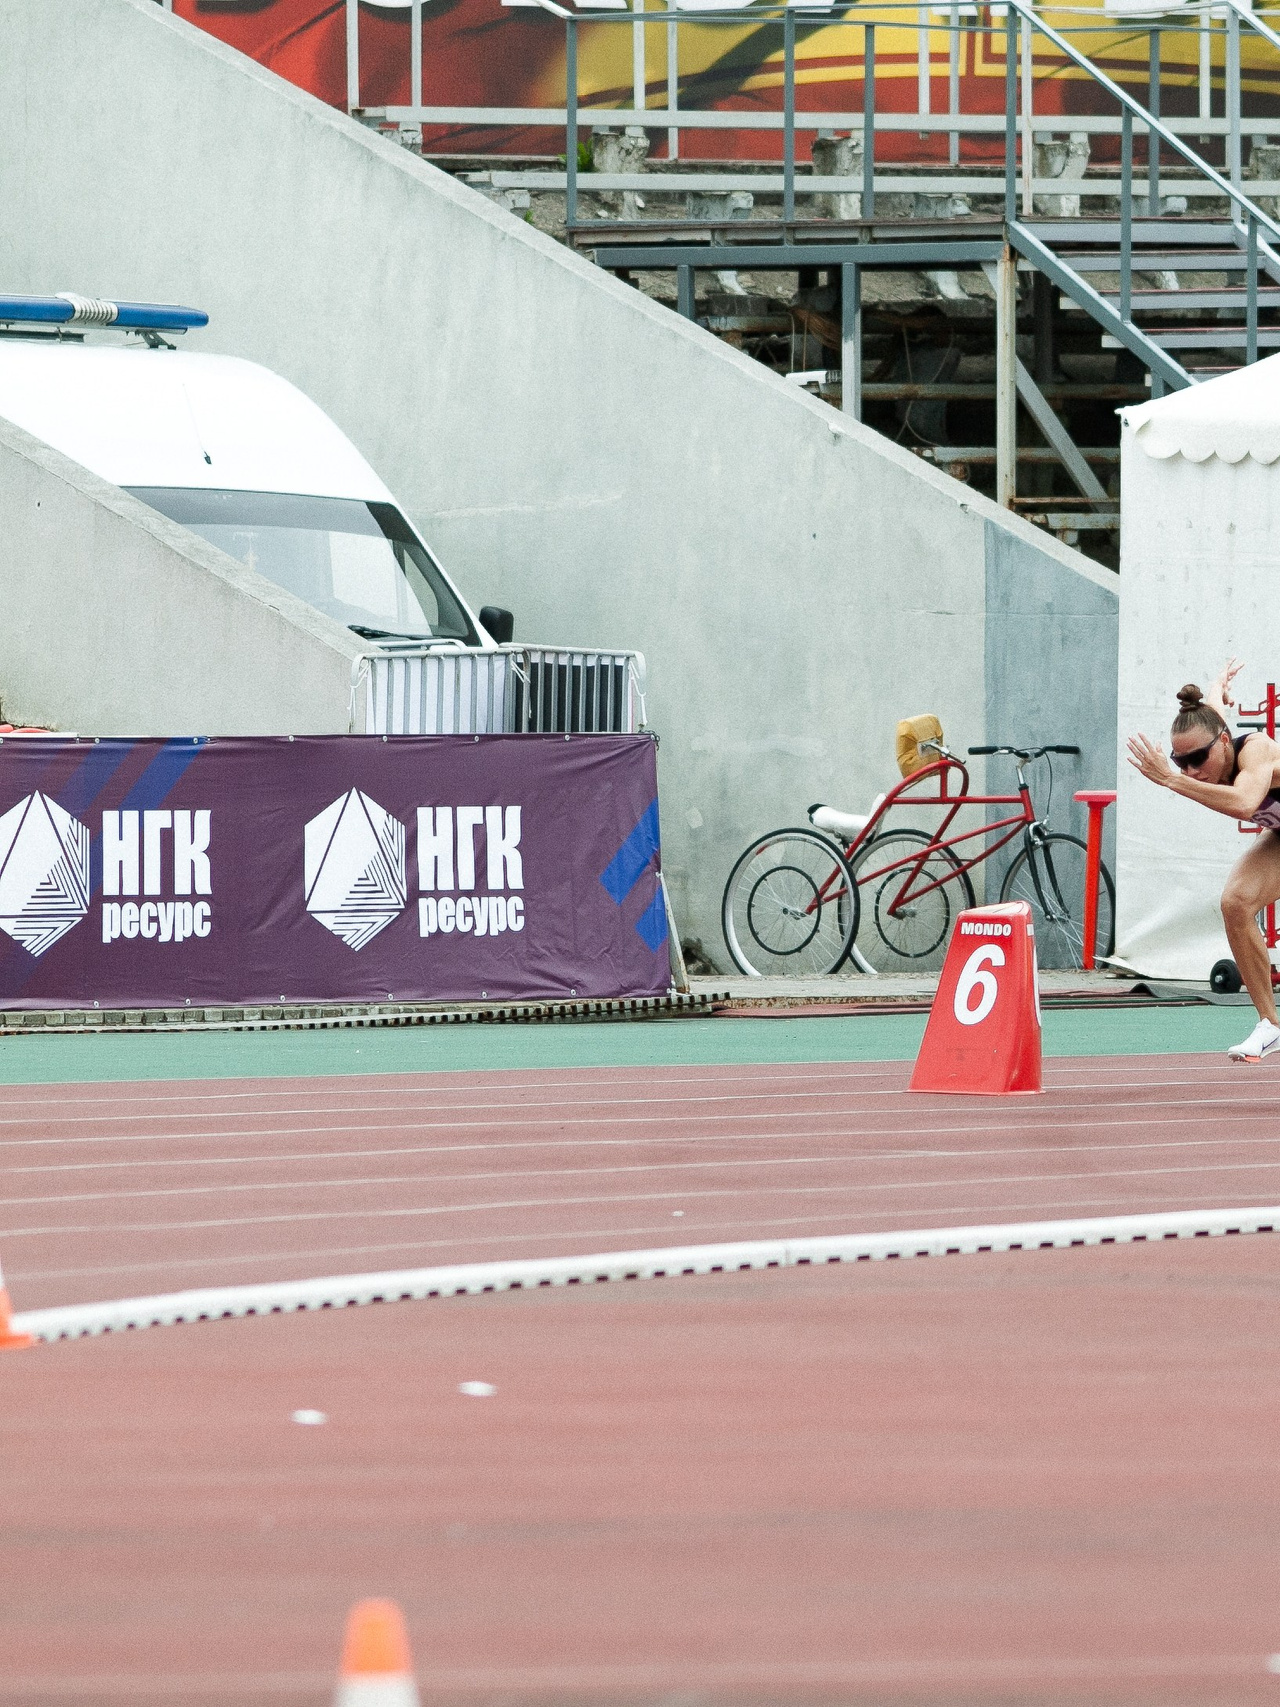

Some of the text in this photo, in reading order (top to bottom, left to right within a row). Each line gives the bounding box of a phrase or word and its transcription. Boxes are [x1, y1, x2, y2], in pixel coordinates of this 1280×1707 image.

[102, 810, 212, 895] НГК
[417, 806, 525, 891] НГК
[102, 900, 212, 943] ресурс
[419, 895, 525, 938] ресурс
[960, 922, 1012, 936] MONDO
[953, 943, 1006, 1025] 6
